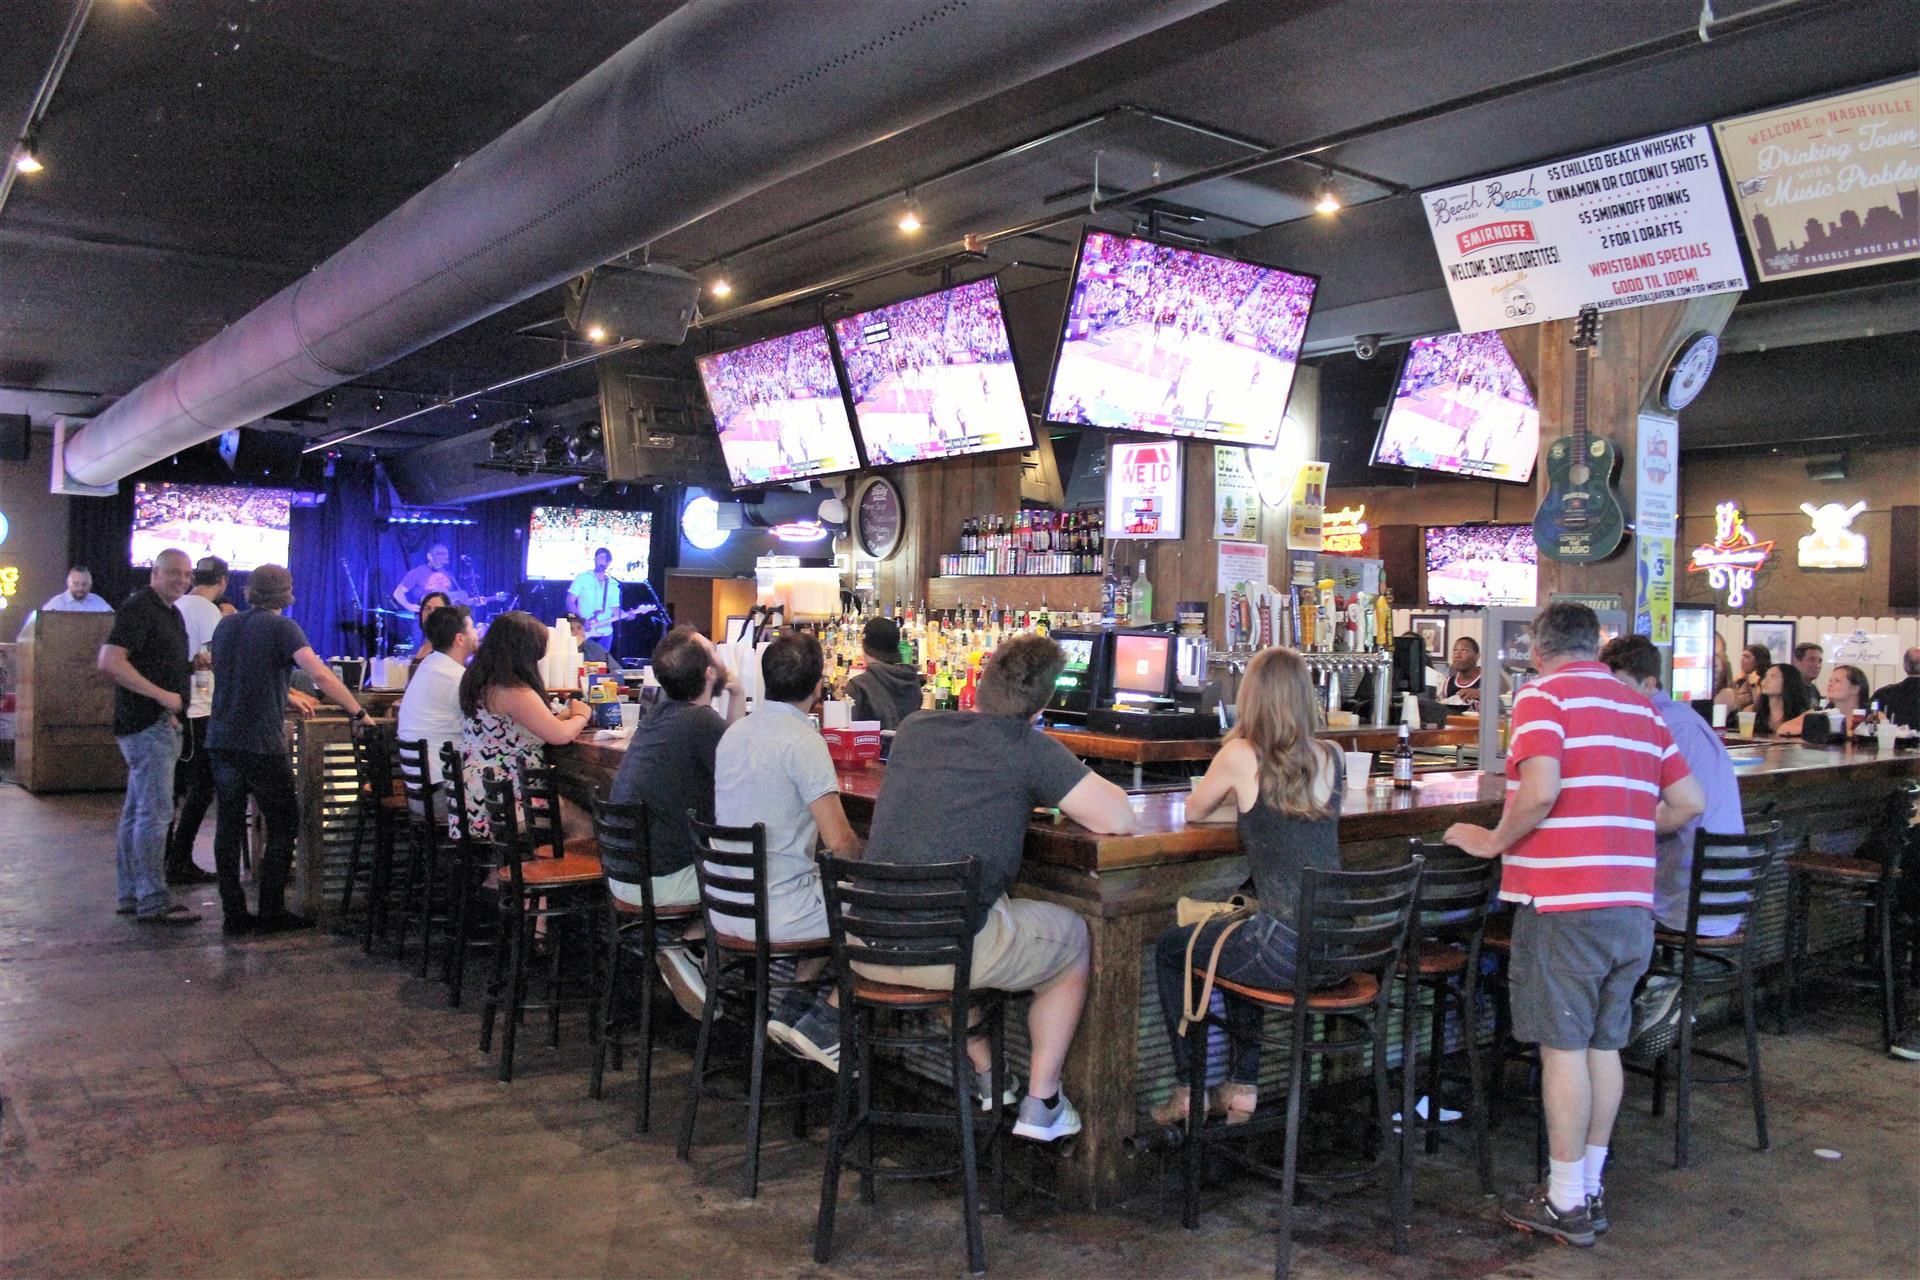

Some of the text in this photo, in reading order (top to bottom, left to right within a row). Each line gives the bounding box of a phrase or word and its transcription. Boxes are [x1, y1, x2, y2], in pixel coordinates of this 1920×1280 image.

[1747, 100, 1913, 145] WELCOME TO NASHVILLE
[1758, 120, 1918, 172] Drinking Town
[1547, 166, 1561, 180] $5
[1561, 156, 1603, 178] CHILLED
[1605, 147, 1641, 168] BEACH
[1547, 153, 1709, 203] CINNAMON OR COCONUT SHOTS
[1432, 184, 1482, 228] Beach
[1485, 173, 1541, 209] Beach
[1578, 188, 1691, 224] $5 SMIRNOFF DRINKS
[1765, 175, 1836, 207] Music
[1461, 223, 1530, 249] SMIRNOFF
[1600, 220, 1683, 249] 2 FOR 1 DRAFTS
[1489, 245, 1562, 275] BACHELORETTES!
[1588, 242, 1711, 278] WRISTBAND SPECIALS
[1804, 249, 1850, 264] PROUDLY
[1854, 244, 1882, 256] MADE
[1886, 241, 1899, 251] IN
[1612, 266, 1700, 296] GOOD TIL 10PM!
[1691, 284, 1706, 294] FOR
[1706, 280, 1726, 292] MORE
[1727, 277, 1744, 289] INFO
[1122, 464, 1146, 484] WE
[1559, 534, 1575, 542] LONG
[1559, 545, 1591, 554] MUSIC
